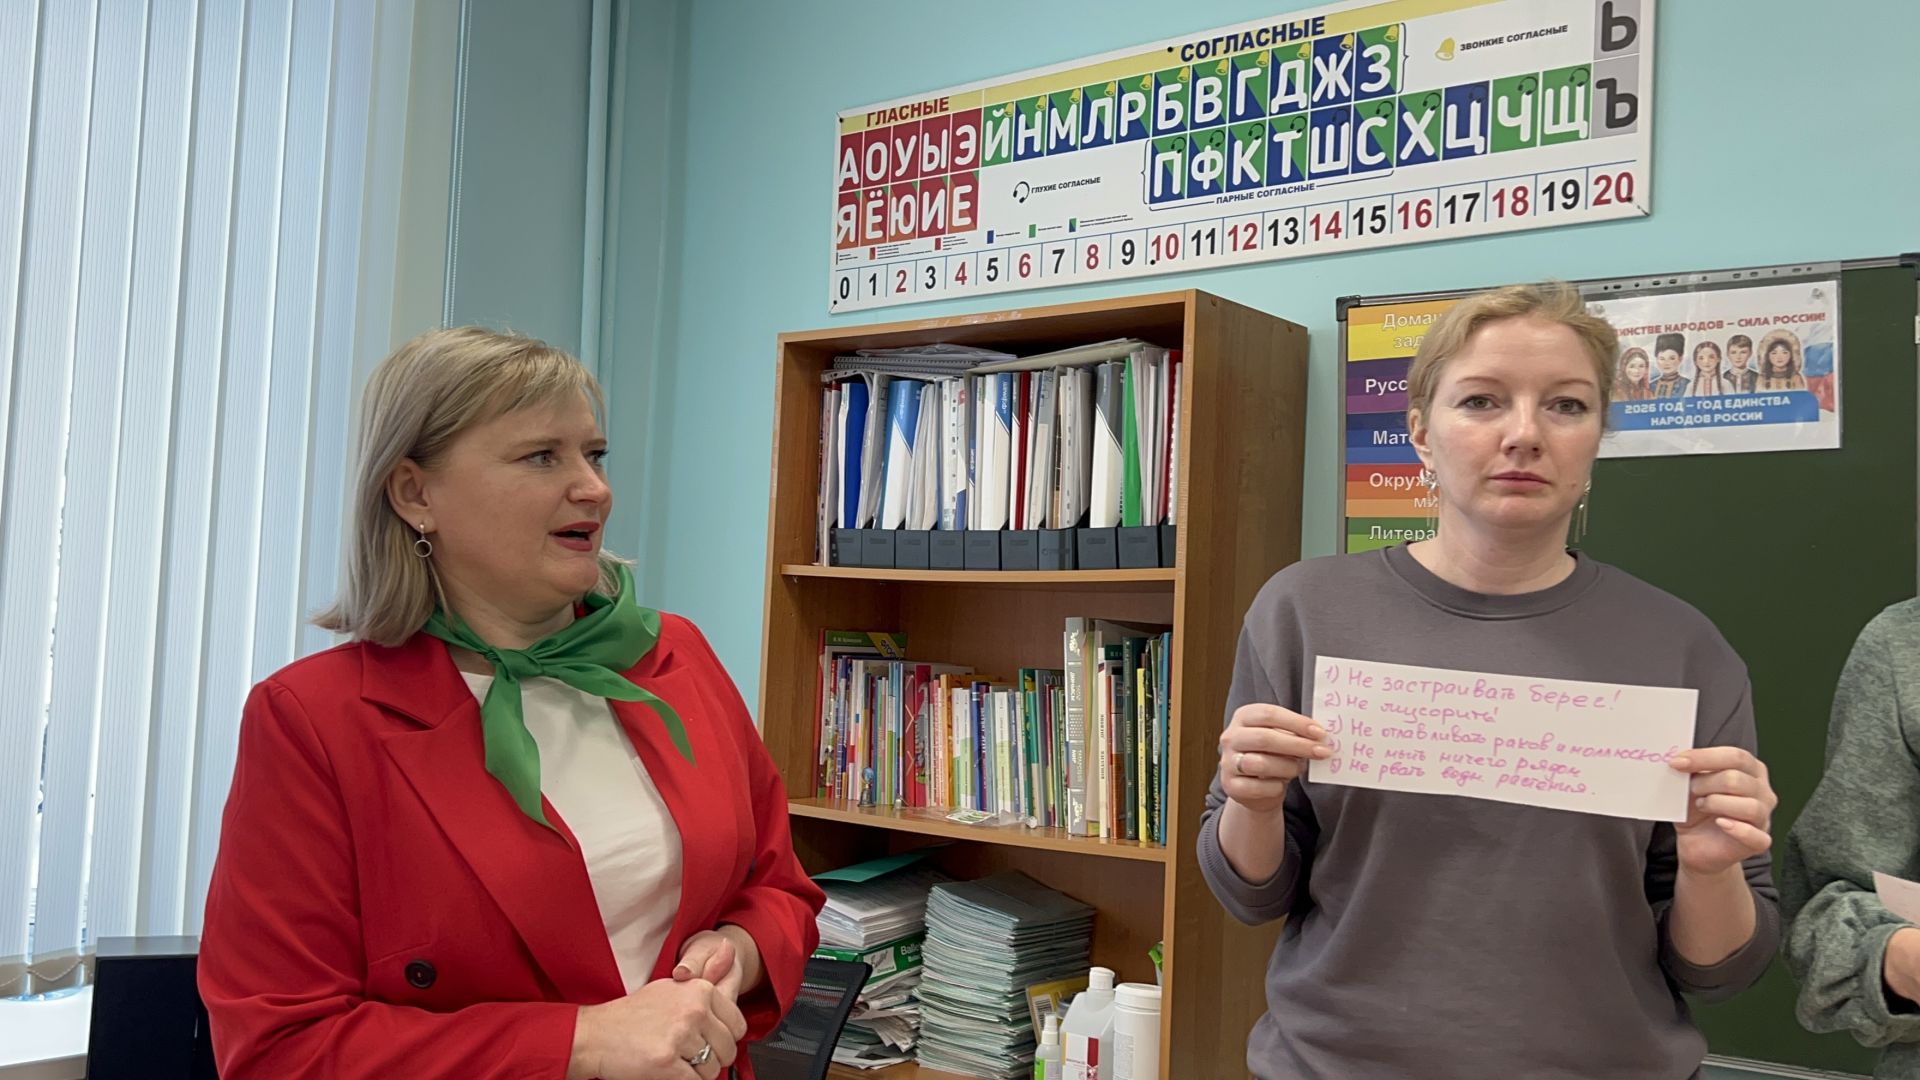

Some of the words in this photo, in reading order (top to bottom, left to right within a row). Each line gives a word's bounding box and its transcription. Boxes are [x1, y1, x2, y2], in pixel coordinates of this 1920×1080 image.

[1180, 16, 1326, 62] СОГЛАСНЫЕ
[1460, 36, 1504, 51] ЗВОНКИЕ
[1506, 24, 1568, 43] СОГЛАСНЫЕ
[866, 96, 950, 127] ГЛАСНЫЕ
[1031, 184, 1057, 194] ГЛУХИЕ
[1058, 176, 1101, 190] СОГЛАСНЫЕ
[1216, 191, 1254, 205] ПАРНЫЕ
[1256, 182, 1316, 199] СОГЛАСНЫЕ
[839, 276, 850, 299] 0
[869, 272, 877, 296] 1
[895, 269, 907, 293] 2
[924, 265, 936, 290] 3
[954, 261, 967, 285] 4
[986, 257, 999, 282] 5
[1018, 253, 1031, 278] 6
[1052, 248, 1065, 274] 7
[1086, 243, 1099, 270] 8
[1121, 238, 1135, 265] 9
[1151, 232, 1180, 261] 10
[1191, 227, 1217, 257] 11
[1227, 222, 1259, 252] 12
[1267, 216, 1300, 247] 13
[1309, 210, 1342, 242] 14
[1352, 204, 1387, 236] 15
[1397, 197, 1433, 230] 16
[1443, 192, 1481, 224] 17
[1492, 185, 1529, 218] 18
[1541, 178, 1581, 212] 19
[1592, 171, 1634, 206] 20
[1382, 313, 1442, 331] Дома
[1664, 320, 1724, 332] НАРОДОВ
[1737, 317, 1770, 328] СИЛА
[1772, 312, 1826, 326] РОССИИ!
[1625, 403, 1657, 415] 2026
[1659, 401, 1684, 413] ГОД
[1696, 399, 1722, 411] ГОД
[1724, 396, 1791, 409] ЕДИНСТВА
[1651, 414, 1711, 427] НАРОДОВ
[1713, 411, 1763, 423] РОССИИ
[1348, 667, 1373, 688] Не
[1382, 676, 1516, 702] застраивать
[1351, 718, 1374, 737] Не
[1493, 732, 1555, 757] раков
[1556, 743, 1566, 752] и
[1353, 742, 1374, 758] Не
[1439, 751, 1507, 768] ничего
